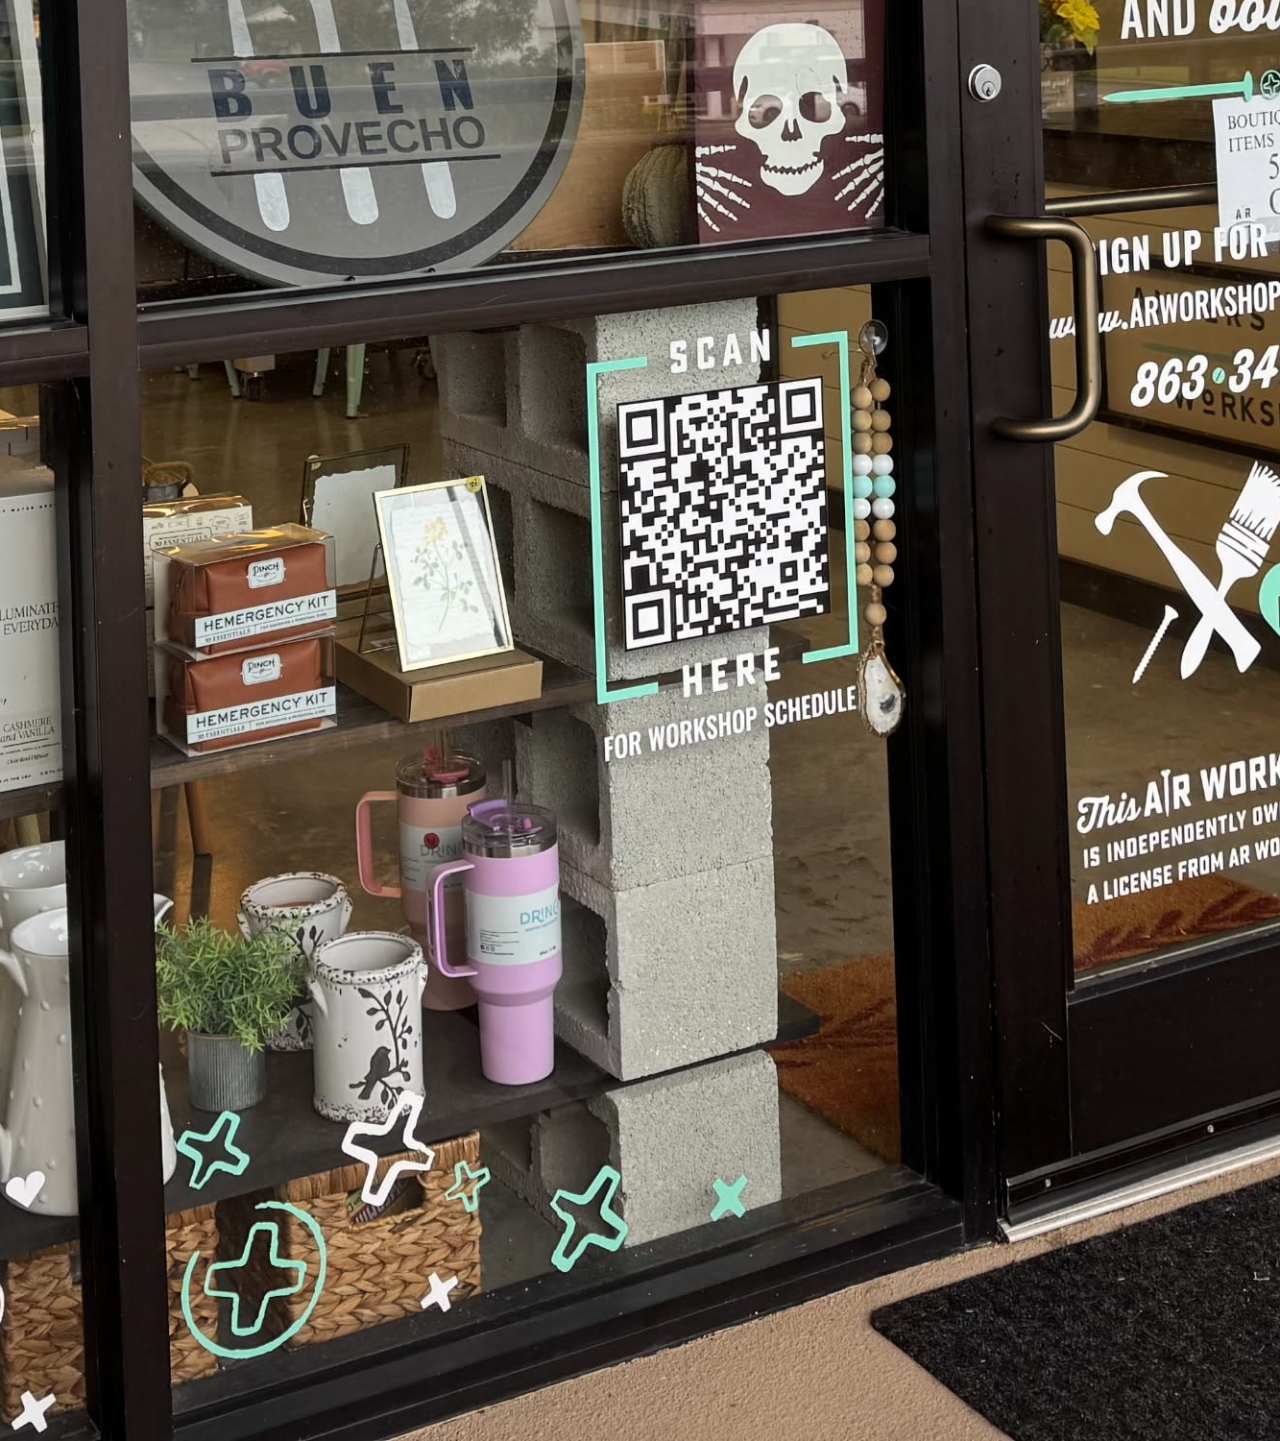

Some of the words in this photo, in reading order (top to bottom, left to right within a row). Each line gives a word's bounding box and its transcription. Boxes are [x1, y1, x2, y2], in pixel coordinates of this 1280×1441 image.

[207, 58, 477, 120] BUEN
[219, 113, 487, 166] PROVECHO
[1228, 132, 1275, 153] ITEMS
[1091, 236, 1151, 275] IGN
[1162, 229, 1203, 269] UP
[1213, 221, 1269, 262] FOR
[668, 328, 771, 375] SCAN
[203, 599, 305, 633] HEMERGENCY
[308, 594, 330, 609] KIT
[681, 646, 782, 699] HERE
[0, 731, 17, 744] and
[17, 723, 55, 741] VANILLA
[2, 716, 52, 734] CASHMERE
[195, 696, 303, 729] HEMERGENCY
[306, 691, 329, 706] KIT
[603, 731, 643, 762] FOR
[647, 706, 759, 752] WORKSHOP
[763, 685, 858, 730] SCHEDULE
[1076, 793, 1142, 835] This
[1082, 847, 1101, 869] IS
[1106, 809, 1247, 864] INDEPENDENTLY
[1086, 883, 1099, 905] A
[1102, 866, 1174, 901] LICENSE
[1177, 851, 1224, 882] FROM
[1228, 844, 1251, 869] AR
